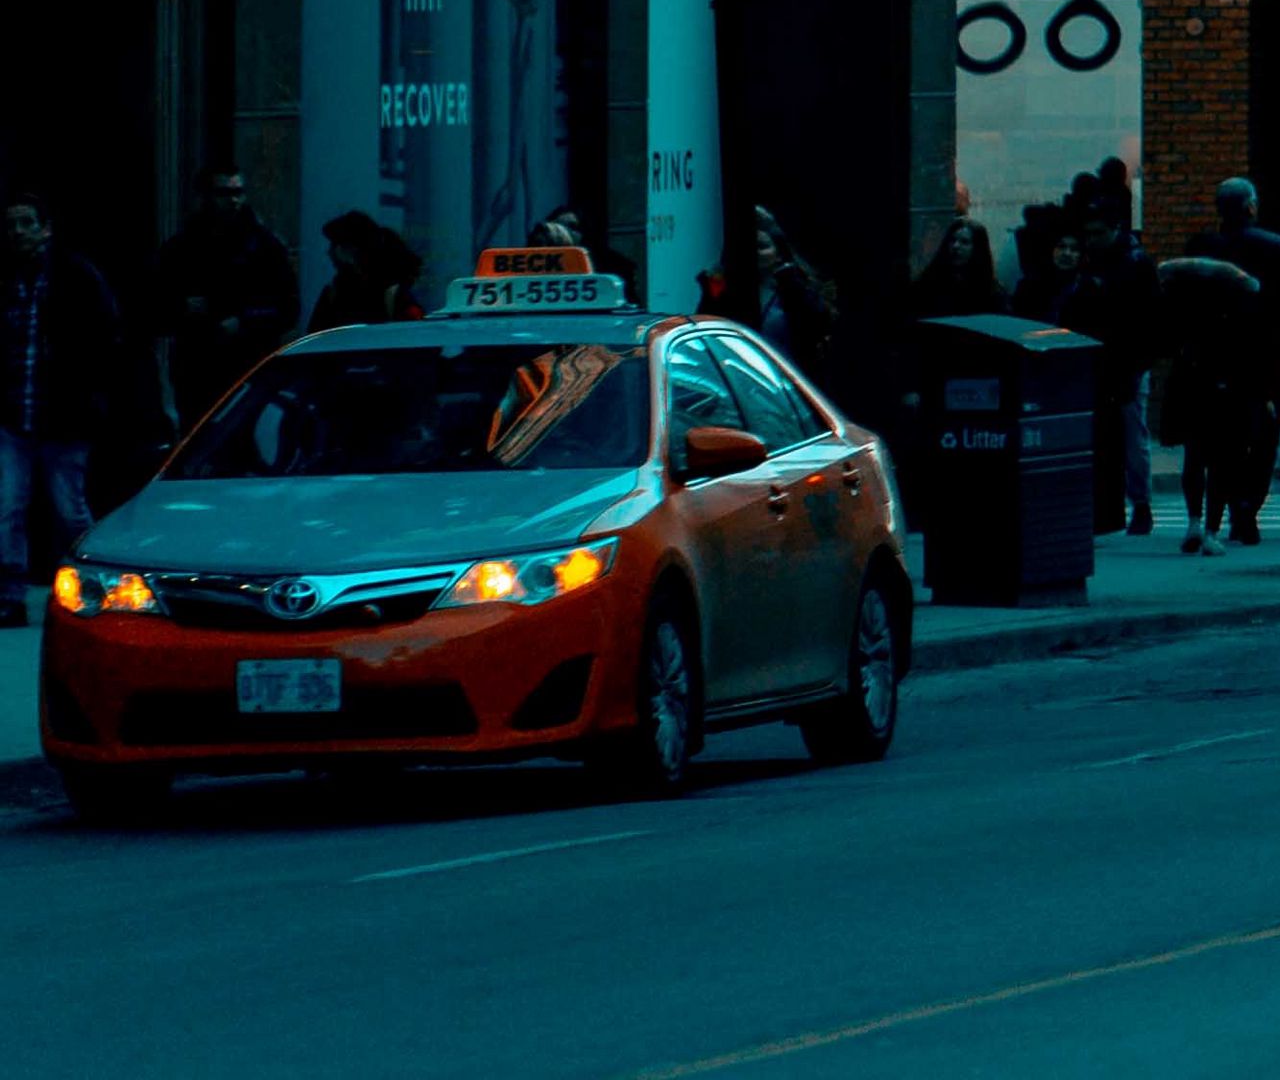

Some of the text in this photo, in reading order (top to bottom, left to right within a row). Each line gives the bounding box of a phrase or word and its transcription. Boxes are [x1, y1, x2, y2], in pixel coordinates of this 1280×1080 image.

[380, 82, 469, 129] RECOVER
[652, 150, 693, 192] RING
[494, 254, 563, 273] BECK
[463, 279, 598, 306] 751-5555
[962, 427, 1008, 450] Litter
